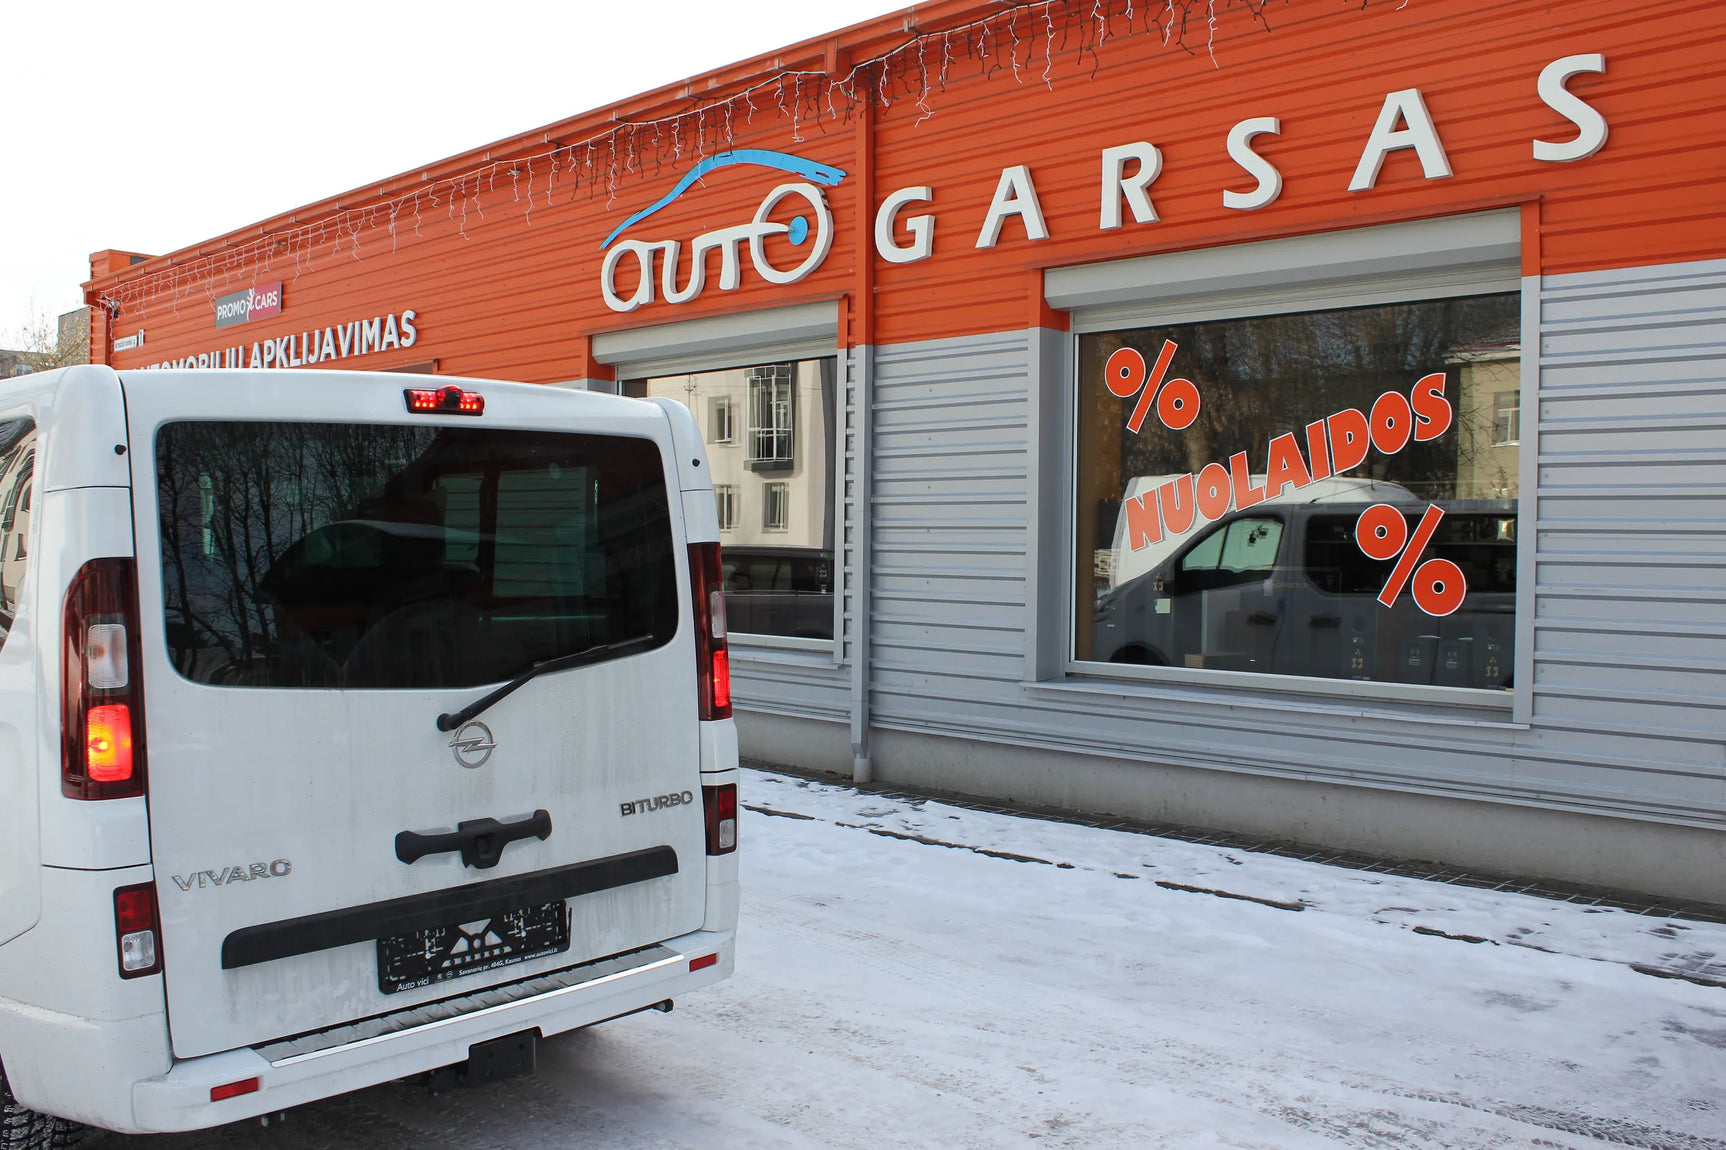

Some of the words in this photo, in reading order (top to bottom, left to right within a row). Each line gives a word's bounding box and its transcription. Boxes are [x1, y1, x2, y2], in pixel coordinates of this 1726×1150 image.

[874, 53, 1609, 264] GARSAS
[217, 299, 246, 321] PROMO
[255, 290, 278, 310] CARS
[250, 310, 417, 369] APKLIJAVIMAS
[1105, 339, 1200, 434] %
[1125, 372, 1452, 552] NUOLAIDOS
[1355, 503, 1467, 617] %
[619, 790, 694, 818] BITURBO
[171, 858, 293, 892] VIVARO
[396, 981, 415, 992] Auto
[417, 976, 430, 987] vici
[505, 957, 521, 965] Kaunas
